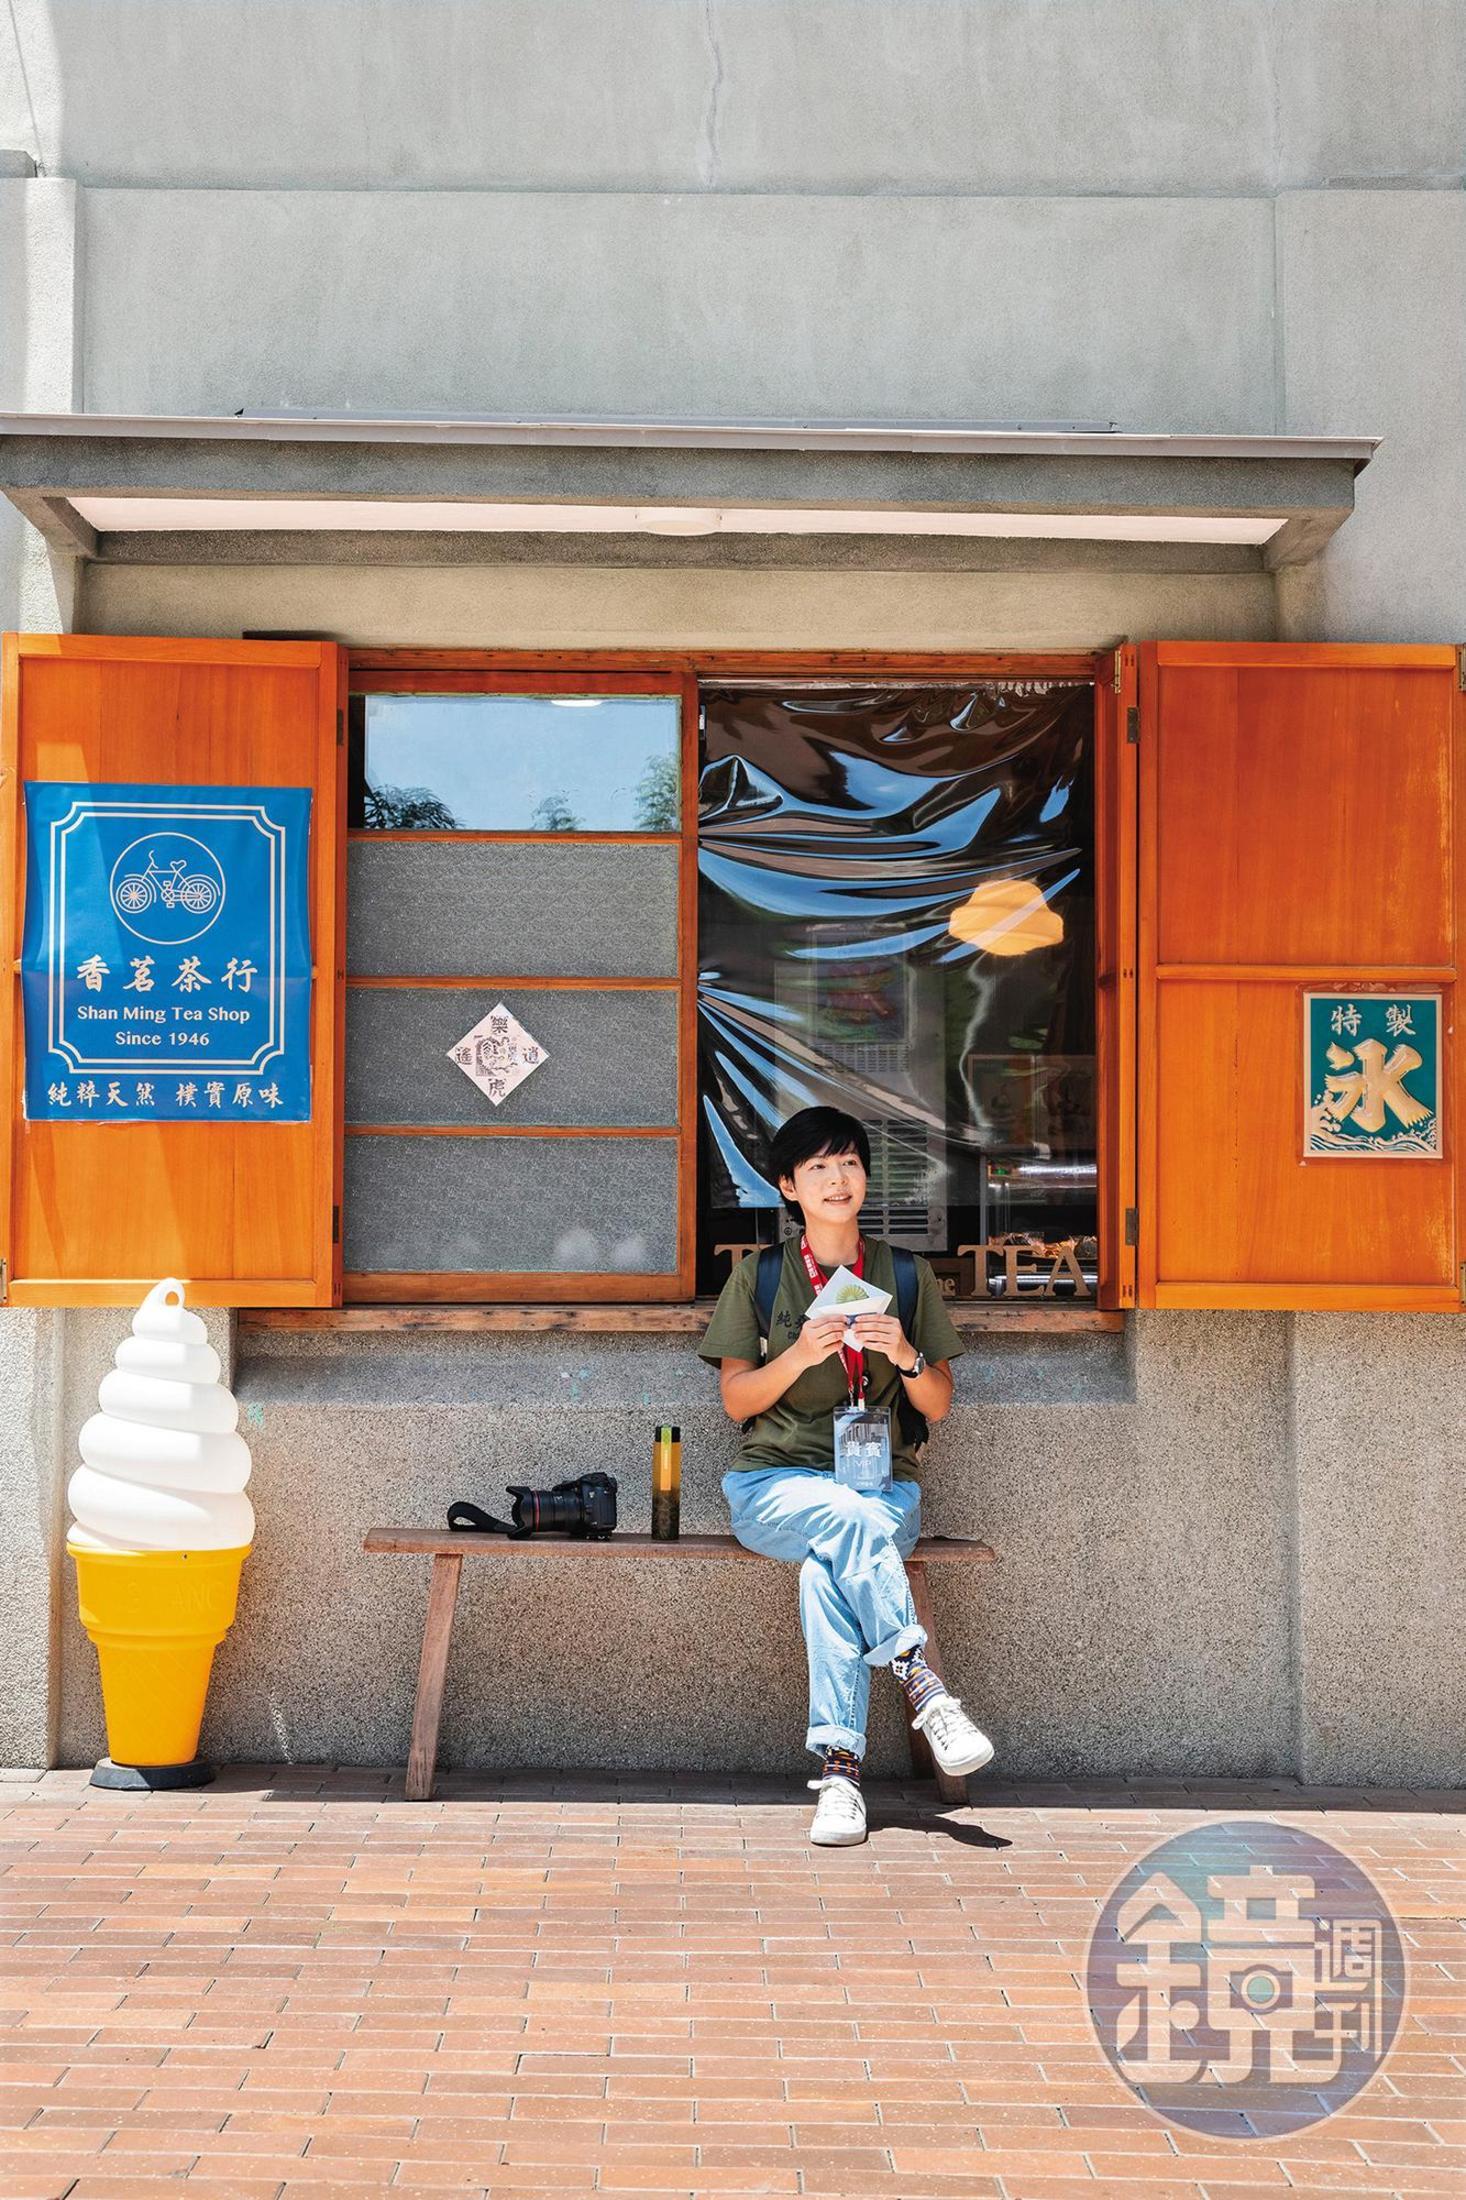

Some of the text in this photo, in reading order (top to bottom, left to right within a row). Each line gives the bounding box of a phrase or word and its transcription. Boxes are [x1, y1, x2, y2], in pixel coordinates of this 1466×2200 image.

[76, 954, 258, 993] 香茗茶行
[77, 1005, 250, 1024] Shan Ming Tea Shop
[1330, 1003, 1417, 1037] 特製
[115, 1031, 210, 1046] Since 1946
[957, 1244, 1092, 1297] TEA
